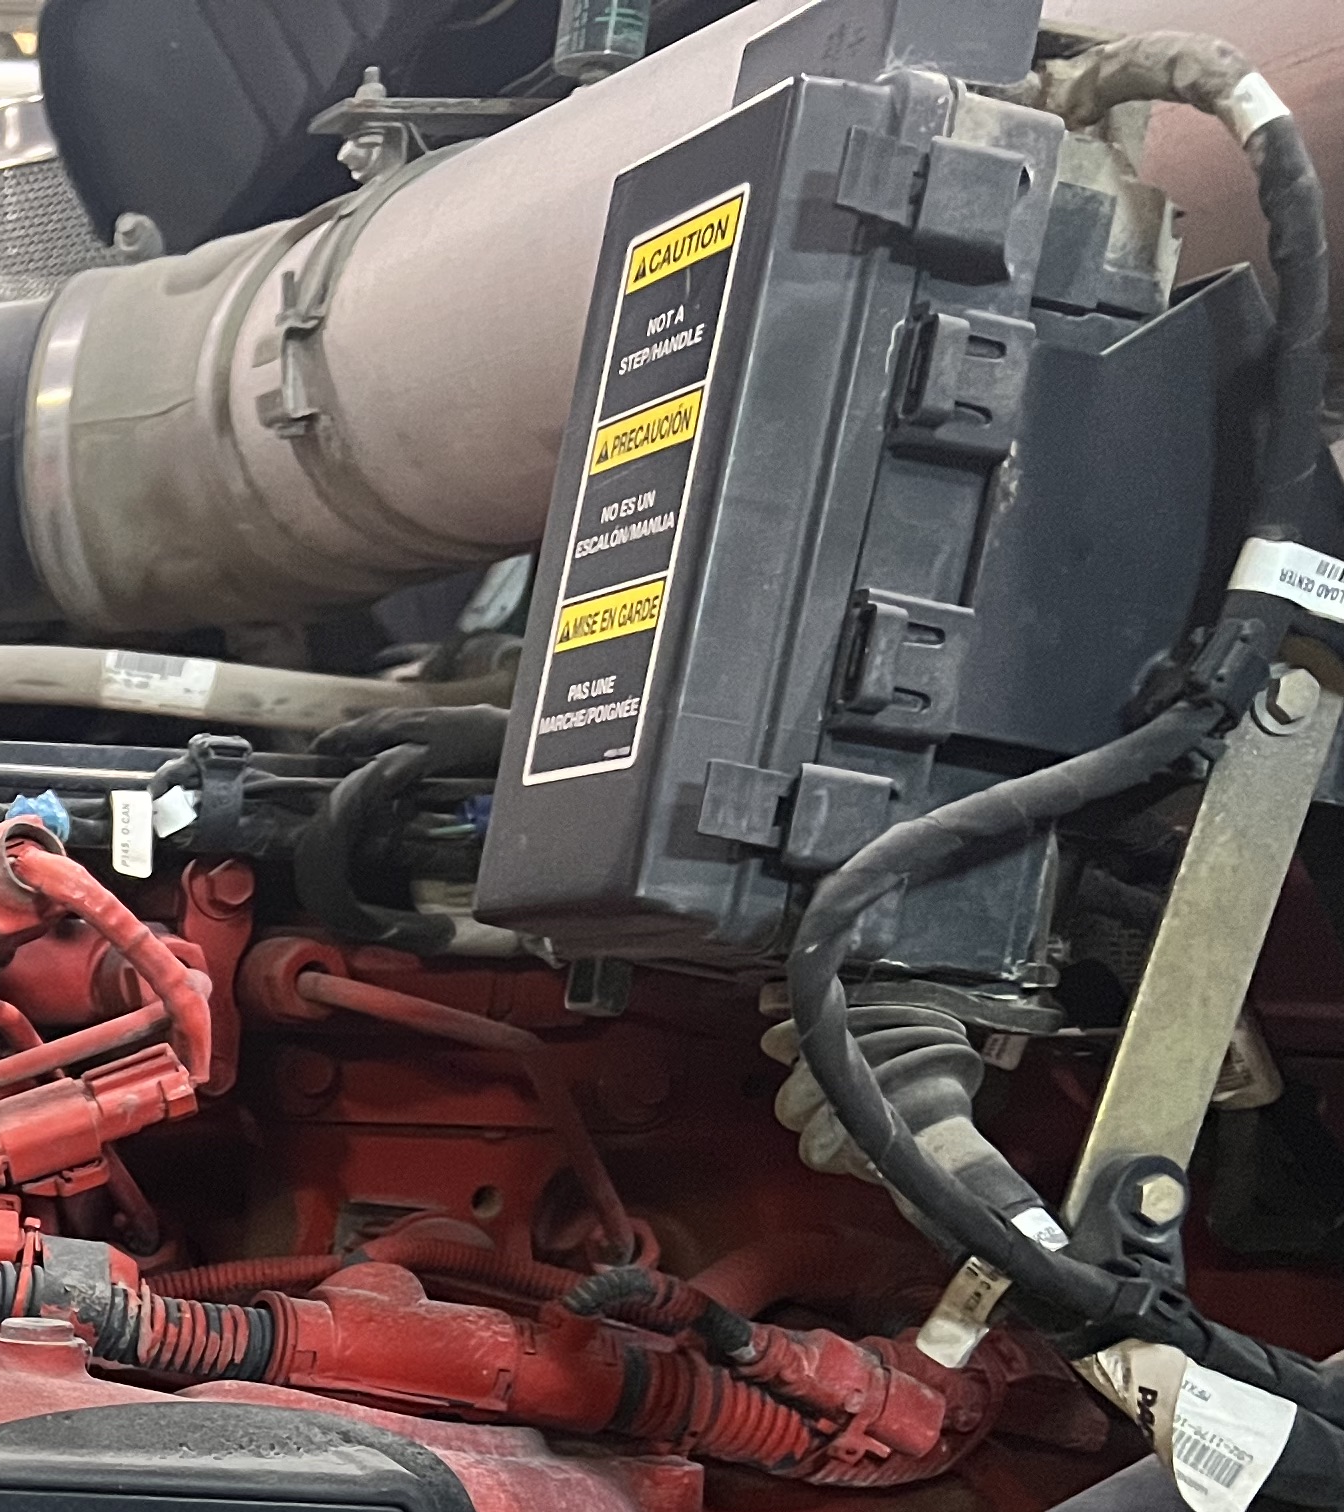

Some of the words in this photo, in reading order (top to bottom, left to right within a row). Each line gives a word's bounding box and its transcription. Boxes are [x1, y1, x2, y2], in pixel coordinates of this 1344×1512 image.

[648, 214, 730, 274] CAUTION
[647, 308, 673, 337] NOT
[673, 304, 685, 324] A
[618, 323, 705, 375] STEP/HANDLE
[611, 403, 693, 459] PRECAUCIÓN
[600, 502, 618, 524] NO
[619, 498, 635, 518] ES
[637, 490, 656, 510] UN
[1279, 568, 1315, 593] CENTER
[572, 613, 600, 640] MISE
[600, 607, 617, 633] EN
[617, 595, 661, 628] GARDE
[567, 681, 591, 704] PAS
[591, 675, 617, 698] UNE
